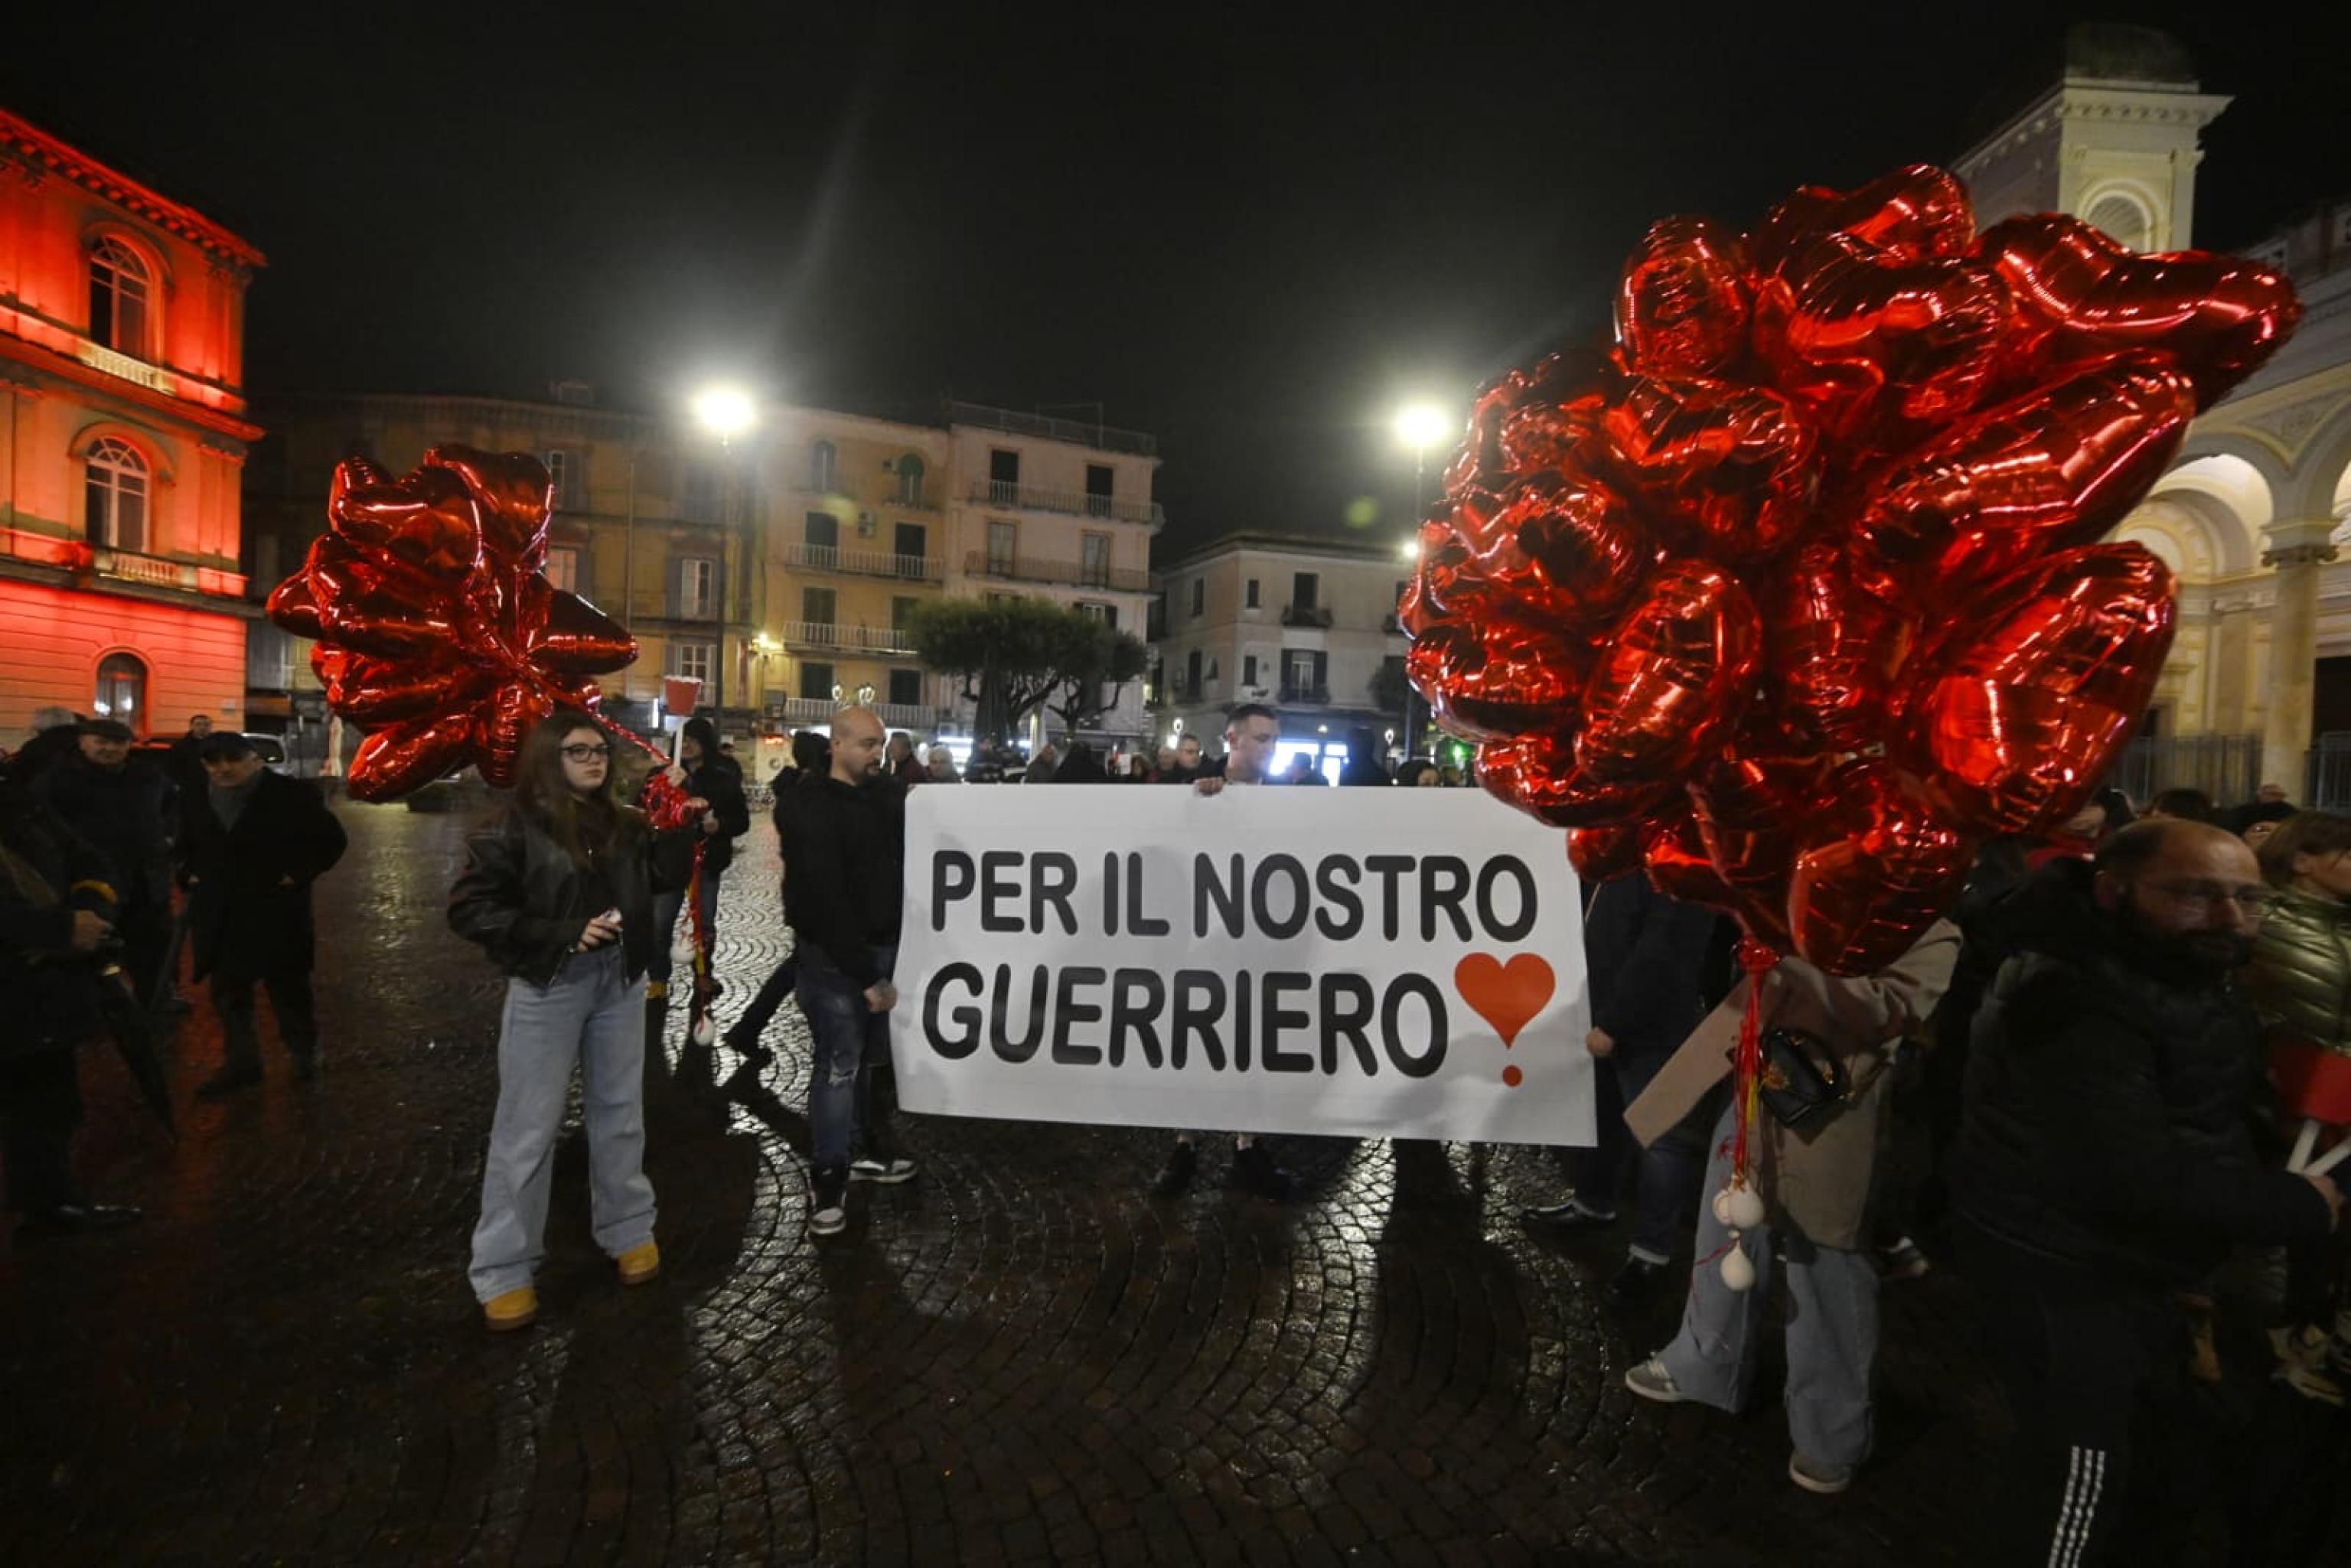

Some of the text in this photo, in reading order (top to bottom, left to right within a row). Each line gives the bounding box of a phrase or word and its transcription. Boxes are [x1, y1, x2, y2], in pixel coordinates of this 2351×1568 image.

[931, 850, 1537, 943] PER IL NOSTRO
[921, 961, 1448, 1079] GUERRIERO
